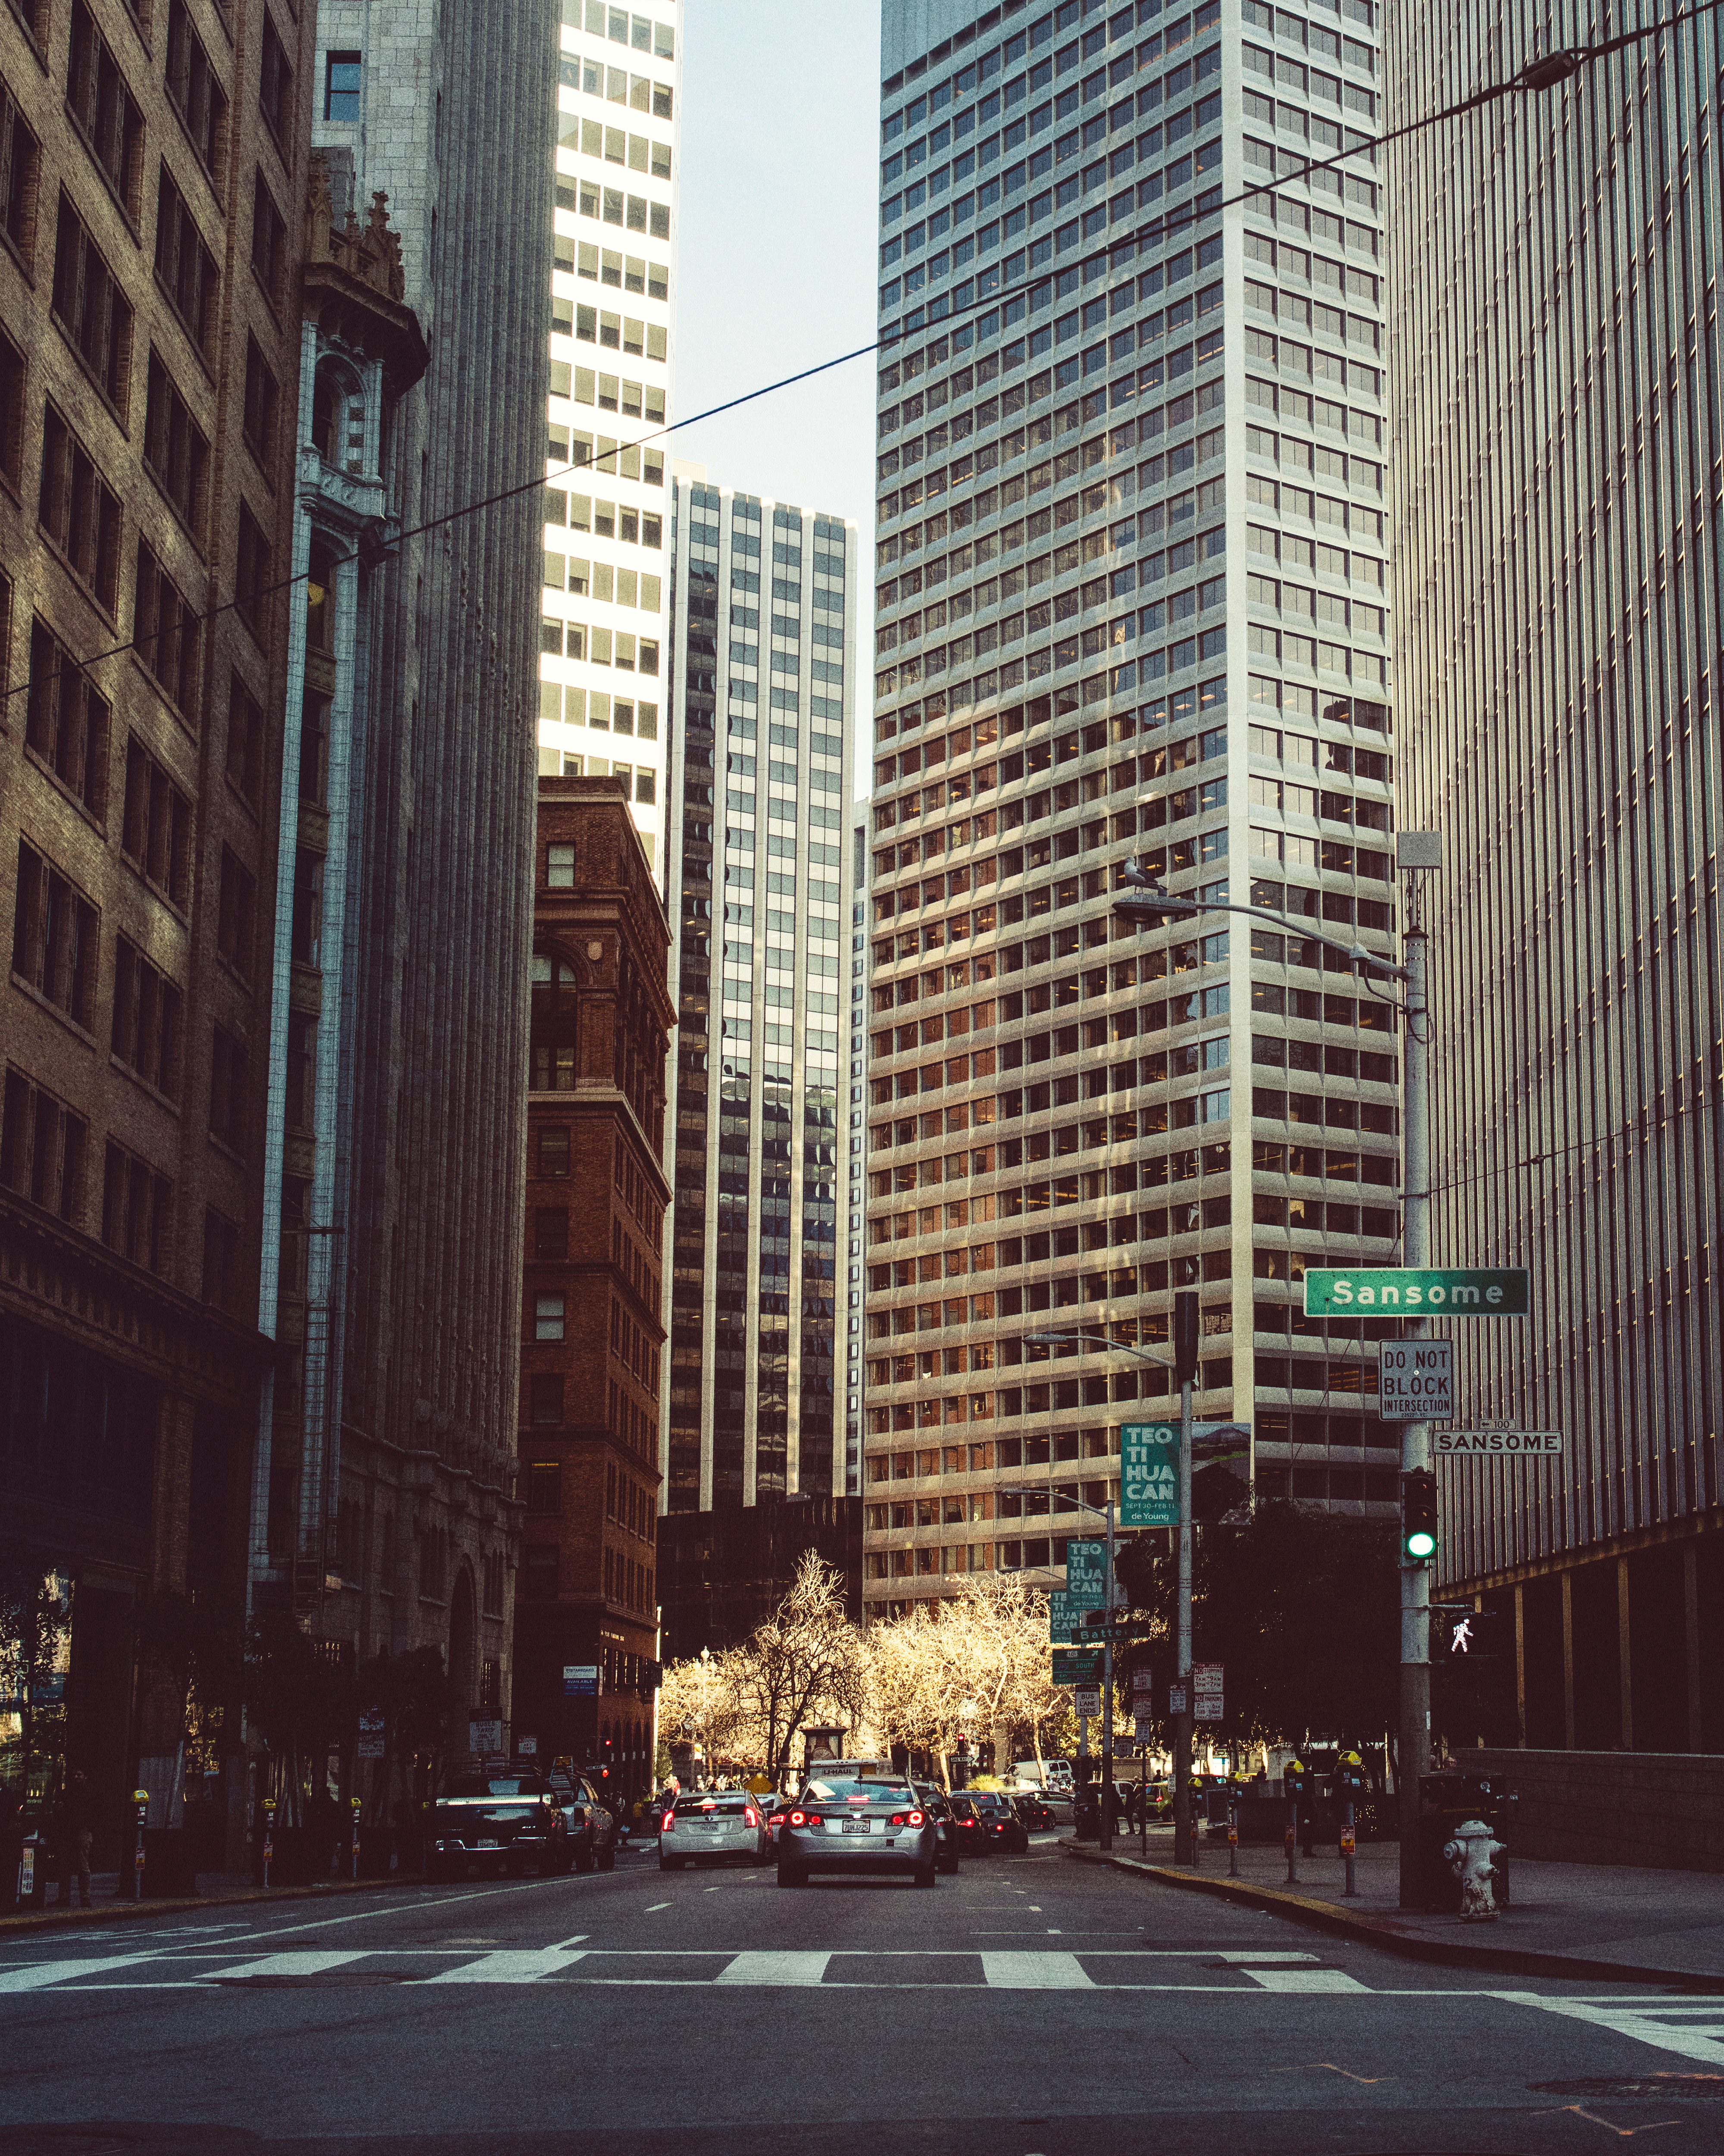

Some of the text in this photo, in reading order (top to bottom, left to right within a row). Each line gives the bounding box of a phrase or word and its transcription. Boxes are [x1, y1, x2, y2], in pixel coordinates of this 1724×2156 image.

[1332, 1280, 1504, 1305] Sansome
[1384, 1350, 1448, 1369] DO NOT
[1384, 1377, 1449, 1395] BLOCK
[1384, 1399, 1449, 1412] INTERSECTION
[1494, 1420, 1509, 1428] 100
[1126, 1427, 1173, 1444] TEO
[1438, 1435, 1558, 1451] SANSOME
[1126, 1446, 1147, 1462] TI
[1126, 1465, 1175, 1481] HUA
[1126, 1484, 1174, 1500] CAN
[1071, 1543, 1102, 1555] TEO
[1070, 1556, 1085, 1567] TI
[1070, 1568, 1104, 1580] HUA
[1070, 1581, 1102, 1593] CAN
[1053, 1602, 1064, 1611] TI
[1053, 1612, 1078, 1621] HUA
[1080, 1627, 1139, 1640] Battery
